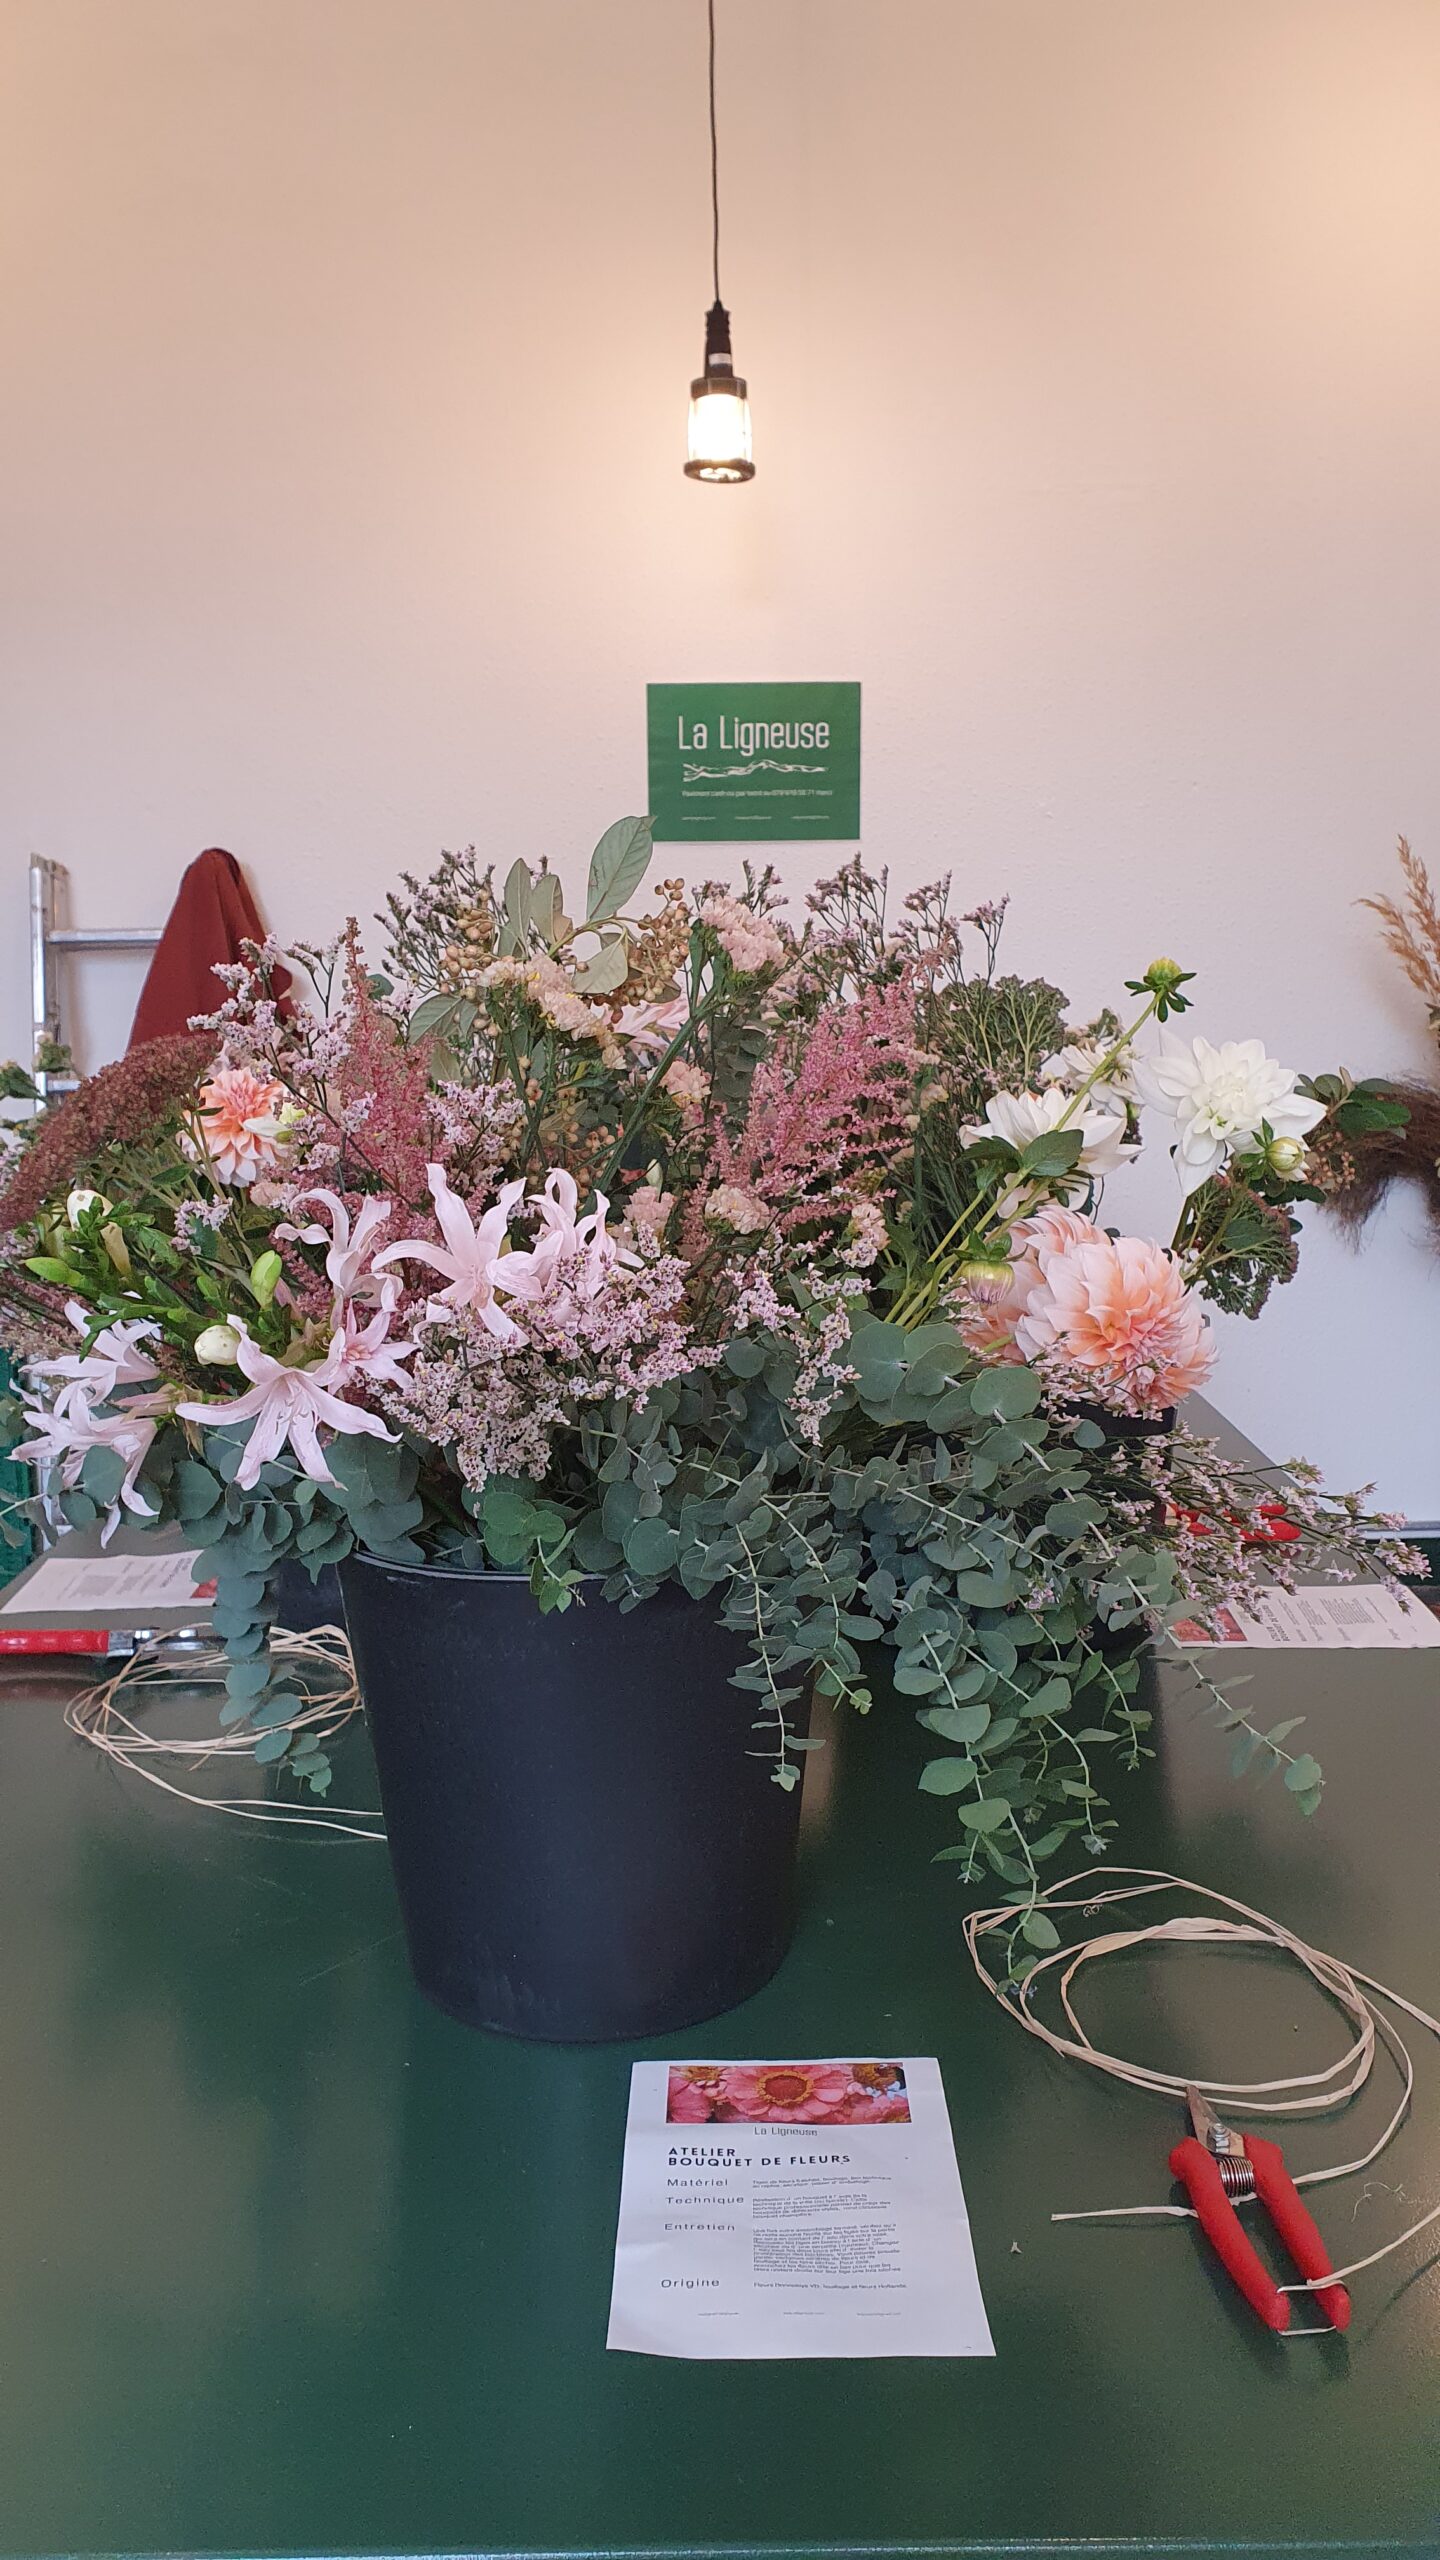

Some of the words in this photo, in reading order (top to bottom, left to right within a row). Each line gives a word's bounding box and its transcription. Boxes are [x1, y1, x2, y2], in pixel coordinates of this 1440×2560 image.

[678, 715, 708, 750] La
[719, 715, 831, 757] Ligneuse
[754, 2127, 767, 2136] La
[771, 2127, 818, 2137] Ligneuse
[668, 2147, 736, 2157] ATELIER
[668, 2157, 752, 2167] BOUQUET
[761, 2157, 782, 2166] DE
[790, 2155, 851, 2166] FLEURS
[667, 2178, 728, 2187] Matériel
[665, 2196, 744, 2205] Technique
[664, 2223, 735, 2231] Entretien
[661, 2278, 720, 2289] Origine
